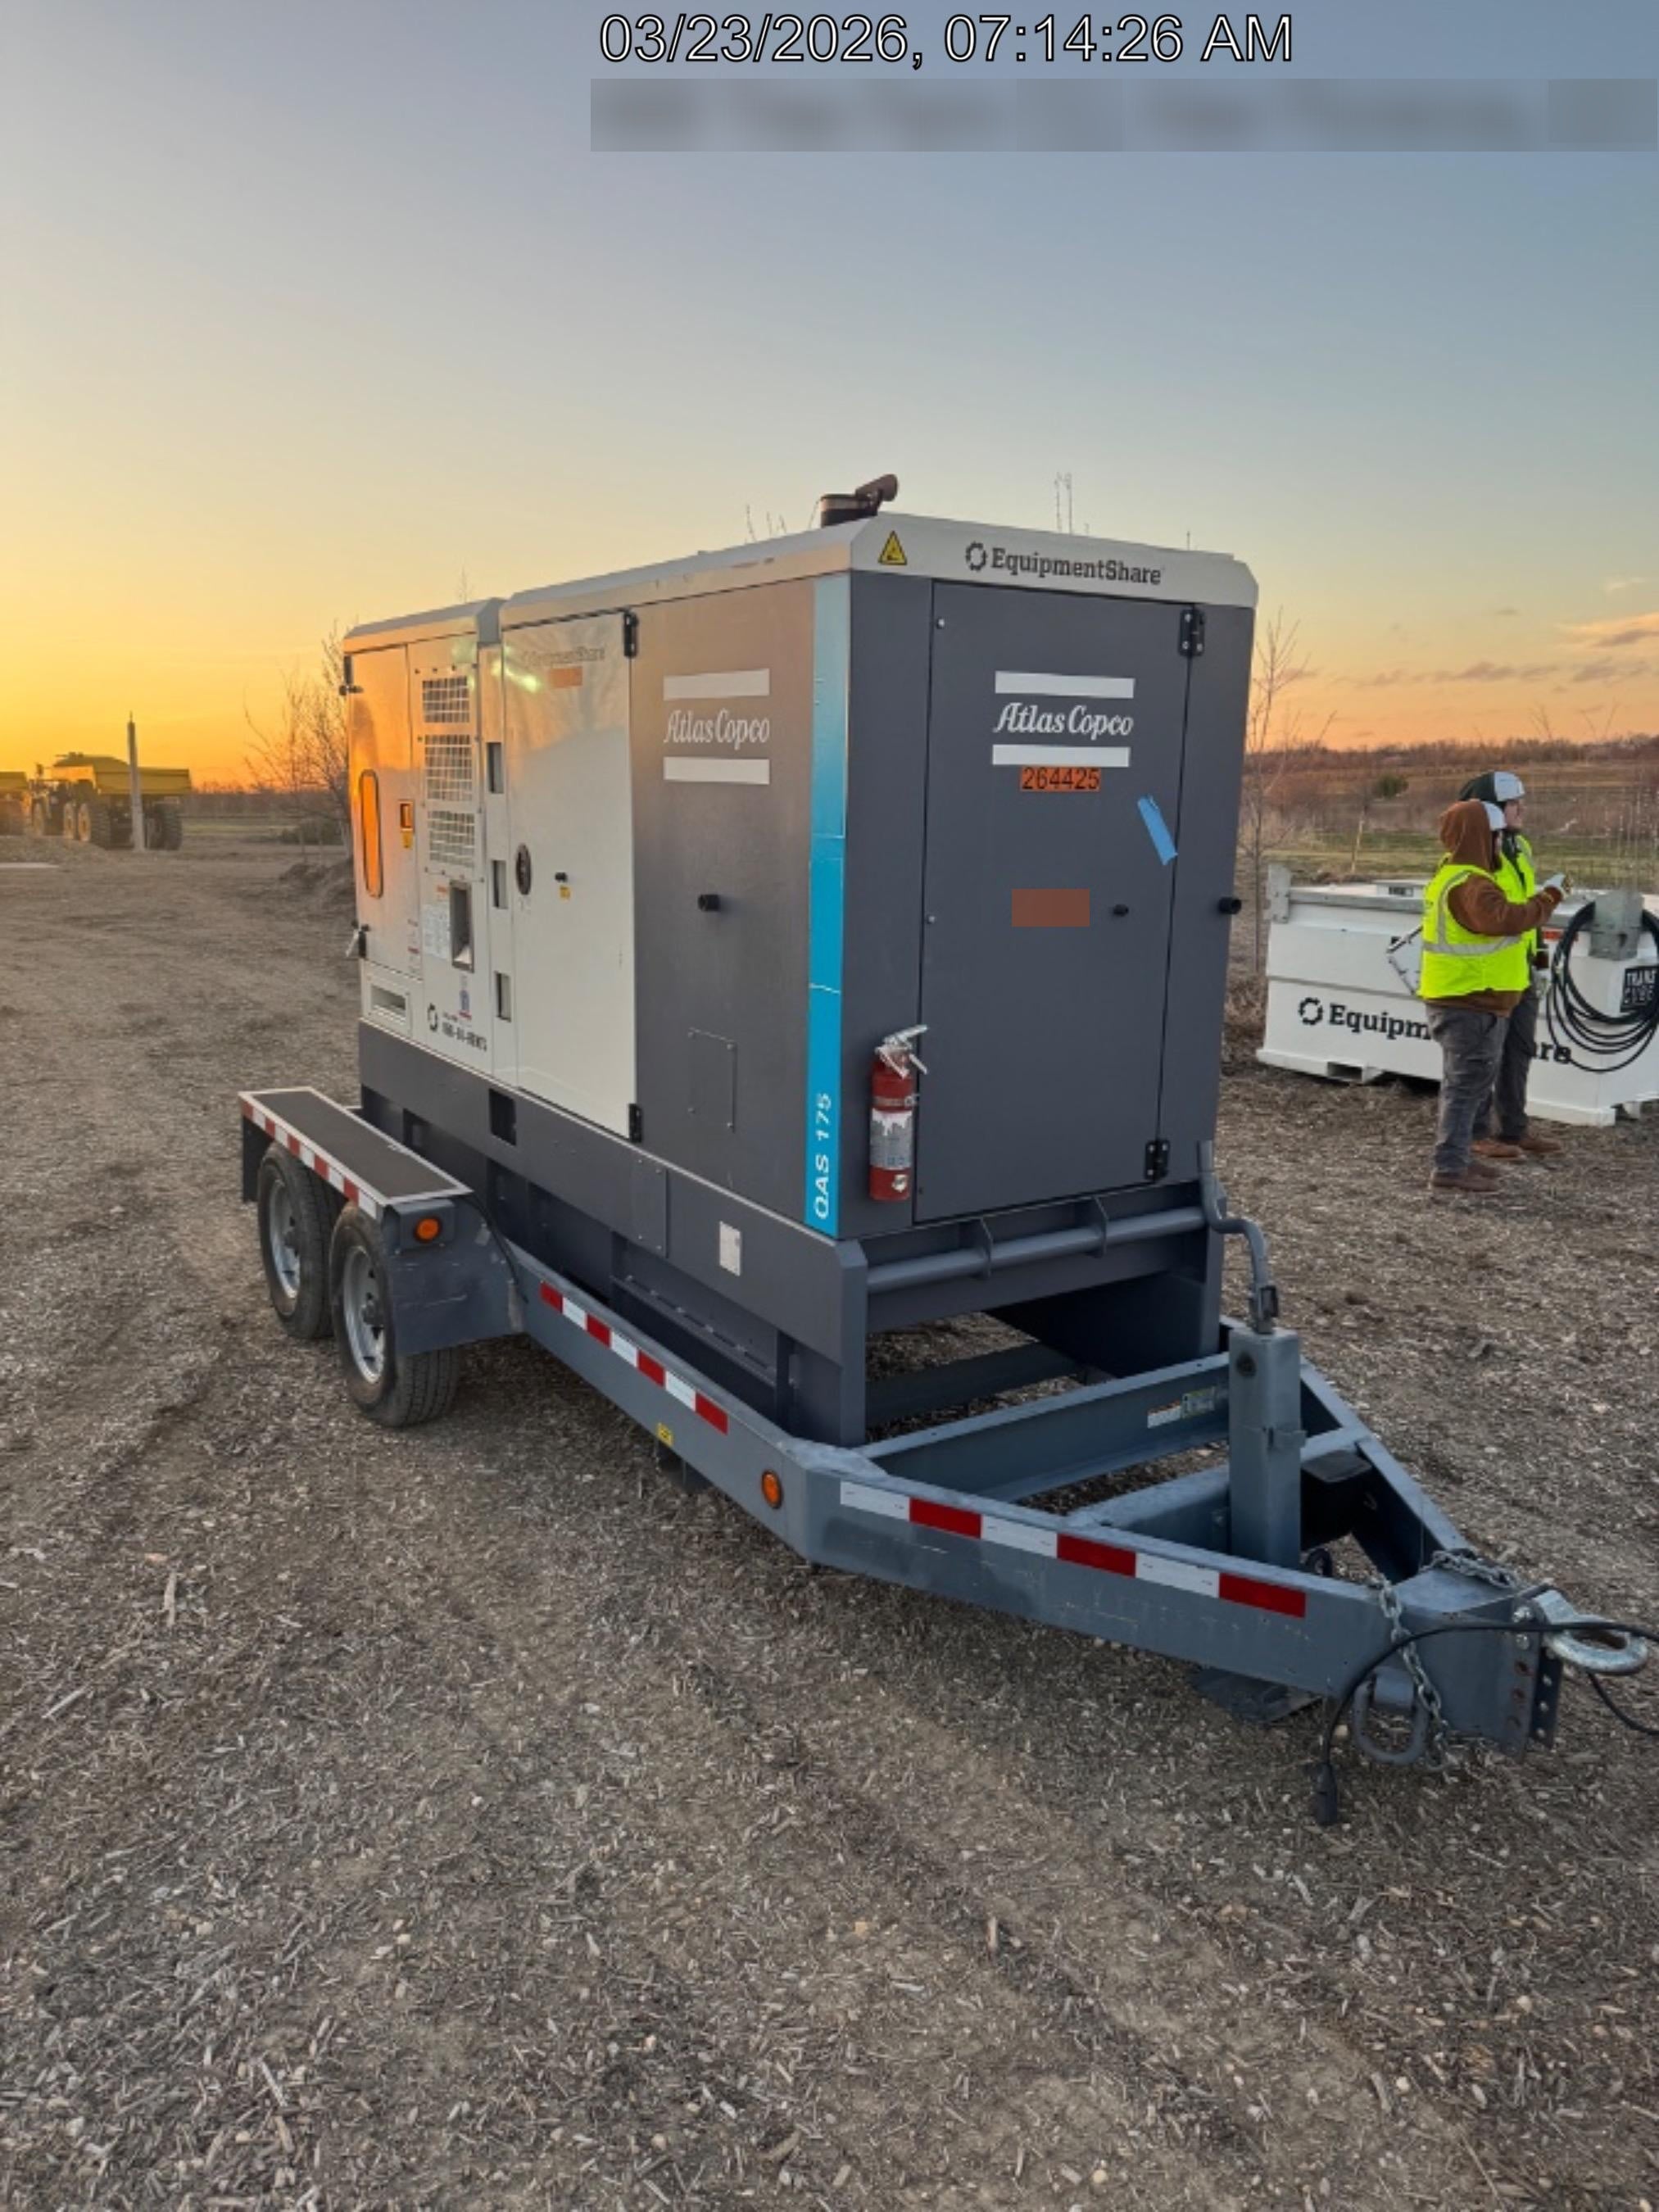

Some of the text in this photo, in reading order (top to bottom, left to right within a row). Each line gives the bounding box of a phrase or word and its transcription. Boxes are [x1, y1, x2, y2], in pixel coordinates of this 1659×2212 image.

[991, 547, 1162, 585] EquipmentShare
[663, 707, 770, 750] Atlas Copco
[993, 702, 1135, 741] Atlas Copco
[1022, 767, 1099, 790] 264425
[814, 1092, 832, 1219] QAS 175
